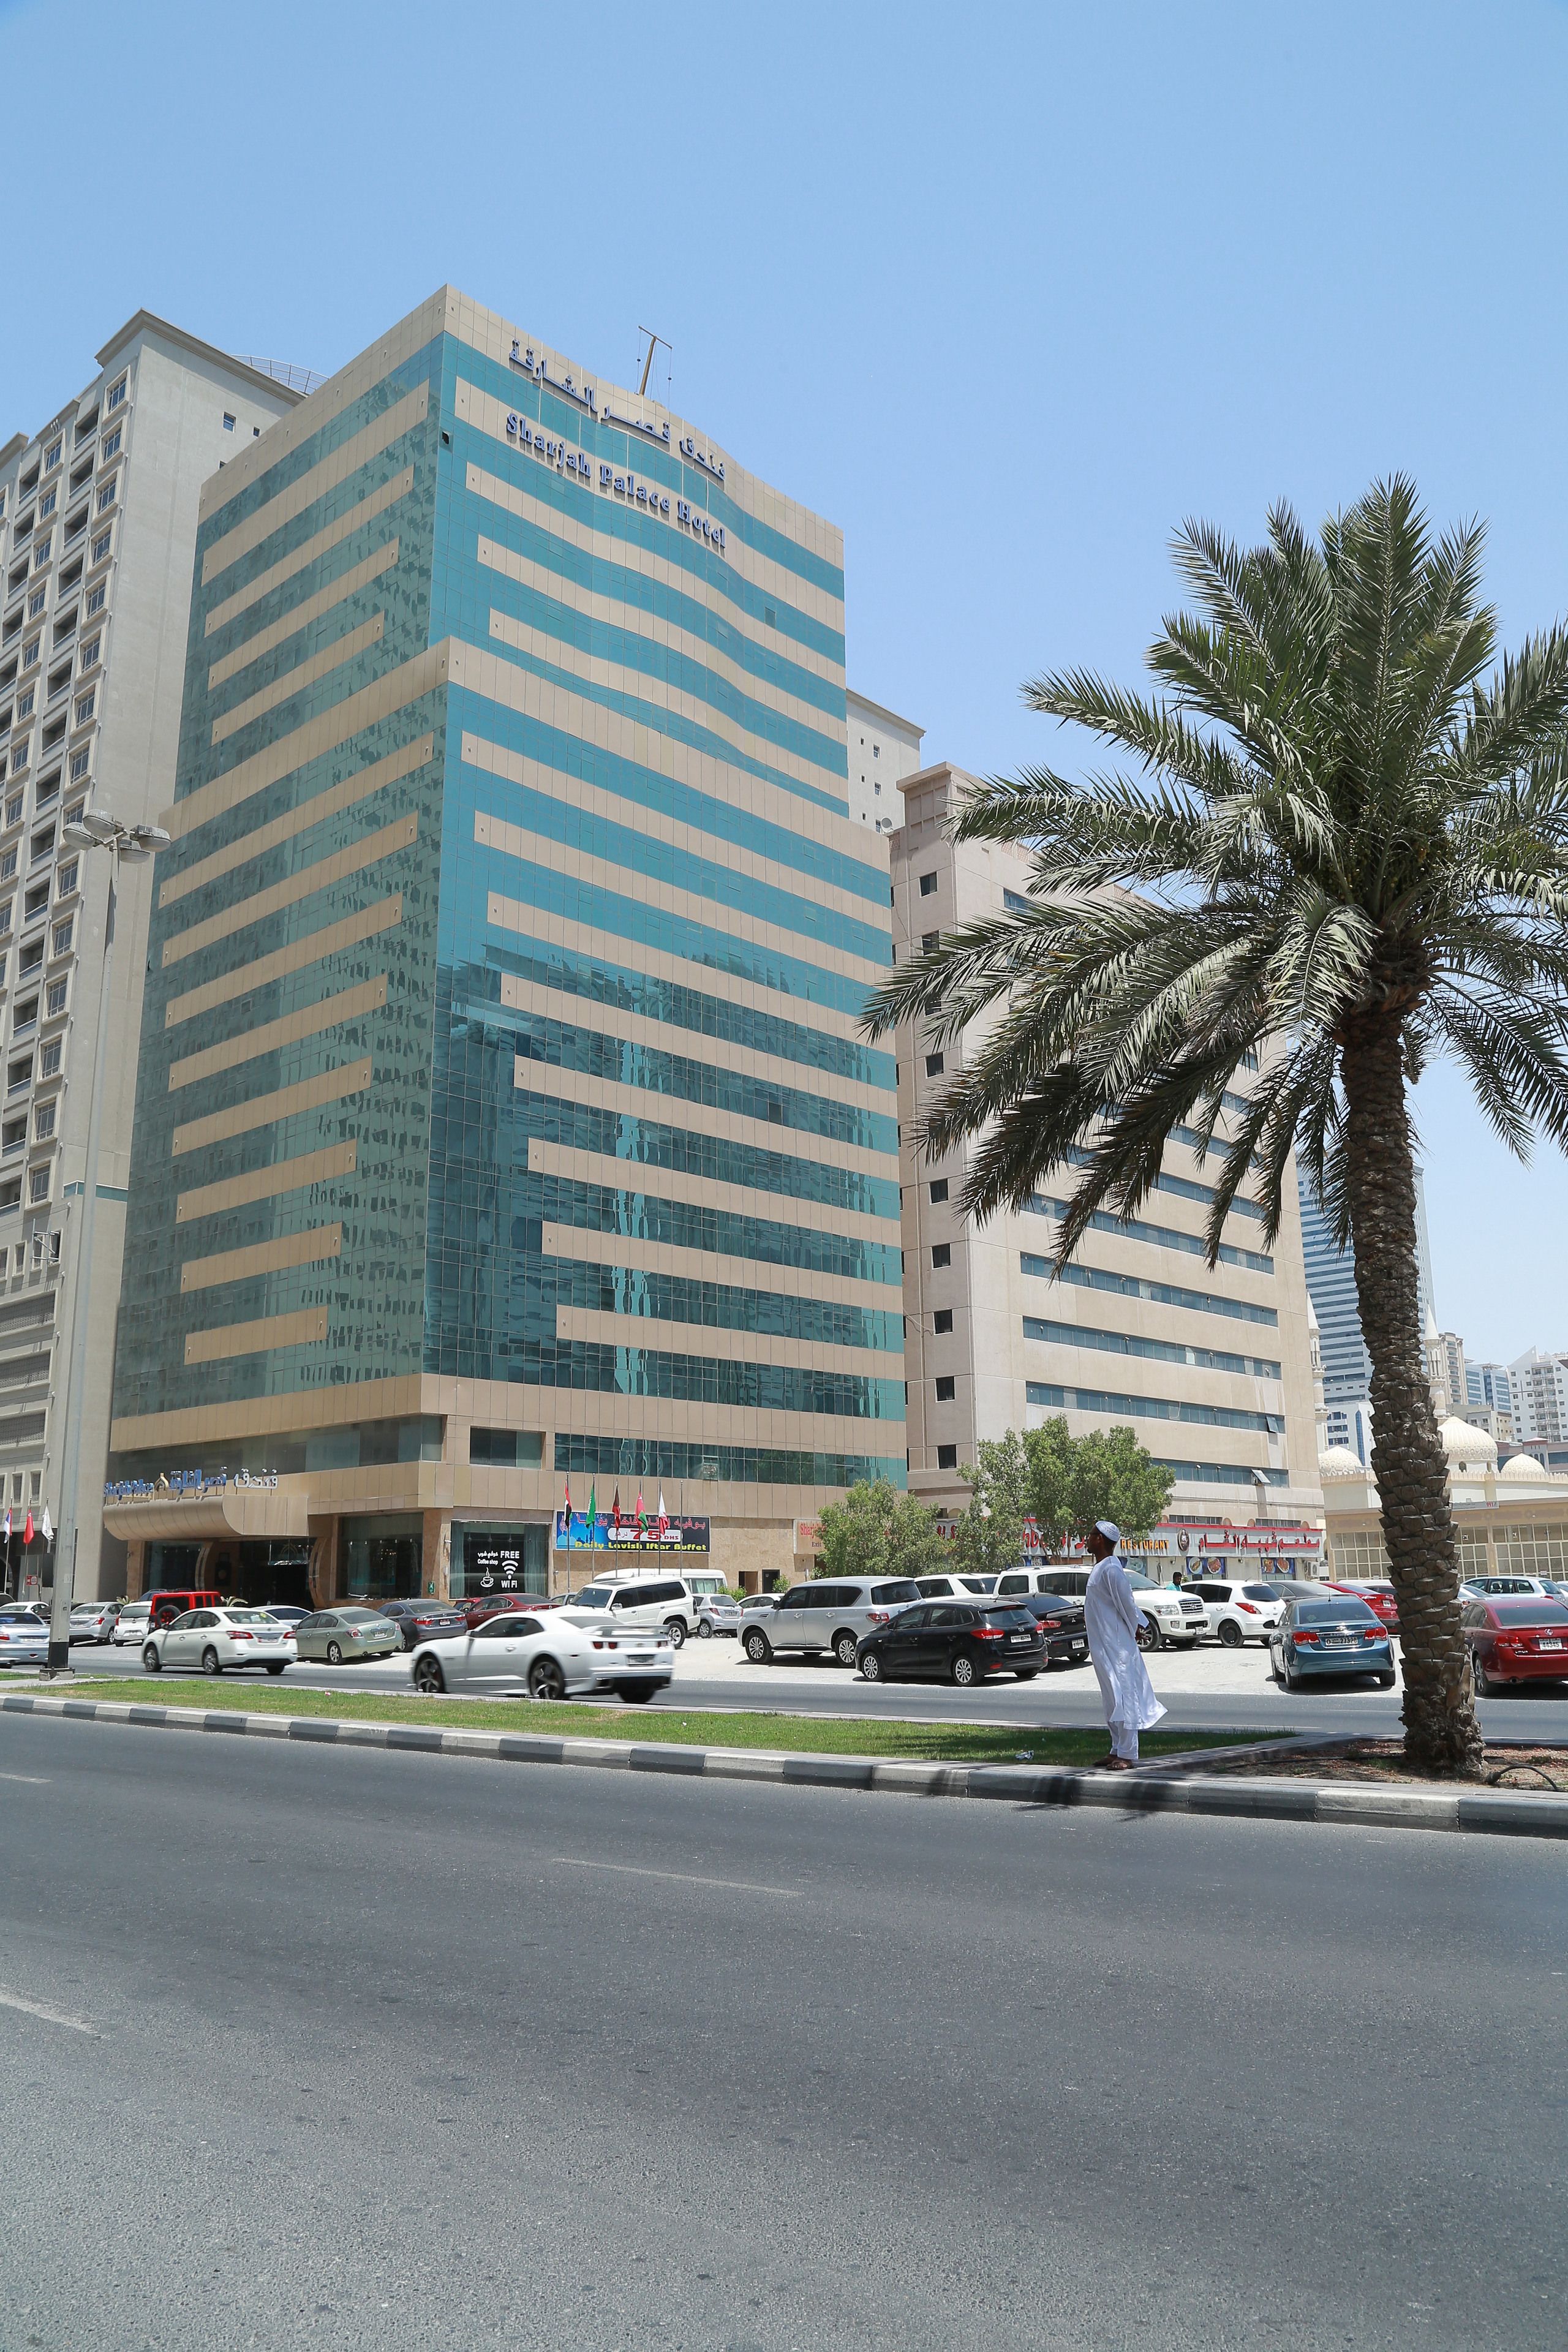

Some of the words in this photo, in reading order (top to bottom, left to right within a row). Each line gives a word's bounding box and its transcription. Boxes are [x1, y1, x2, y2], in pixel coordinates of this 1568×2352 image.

[509, 337, 598, 412] الشارقة
[601, 405, 671, 442] قصر
[679, 437, 726, 480] فندق
[507, 413, 591, 478] Sharjah
[600, 464, 670, 511] Palace
[677, 500, 726, 548] Hotel
[575, 1540, 604, 1550] Daily
[608, 1542, 643, 1550] Lavish
[630, 1529, 661, 1540] 75
[500, 1550, 519, 1559] FREE
